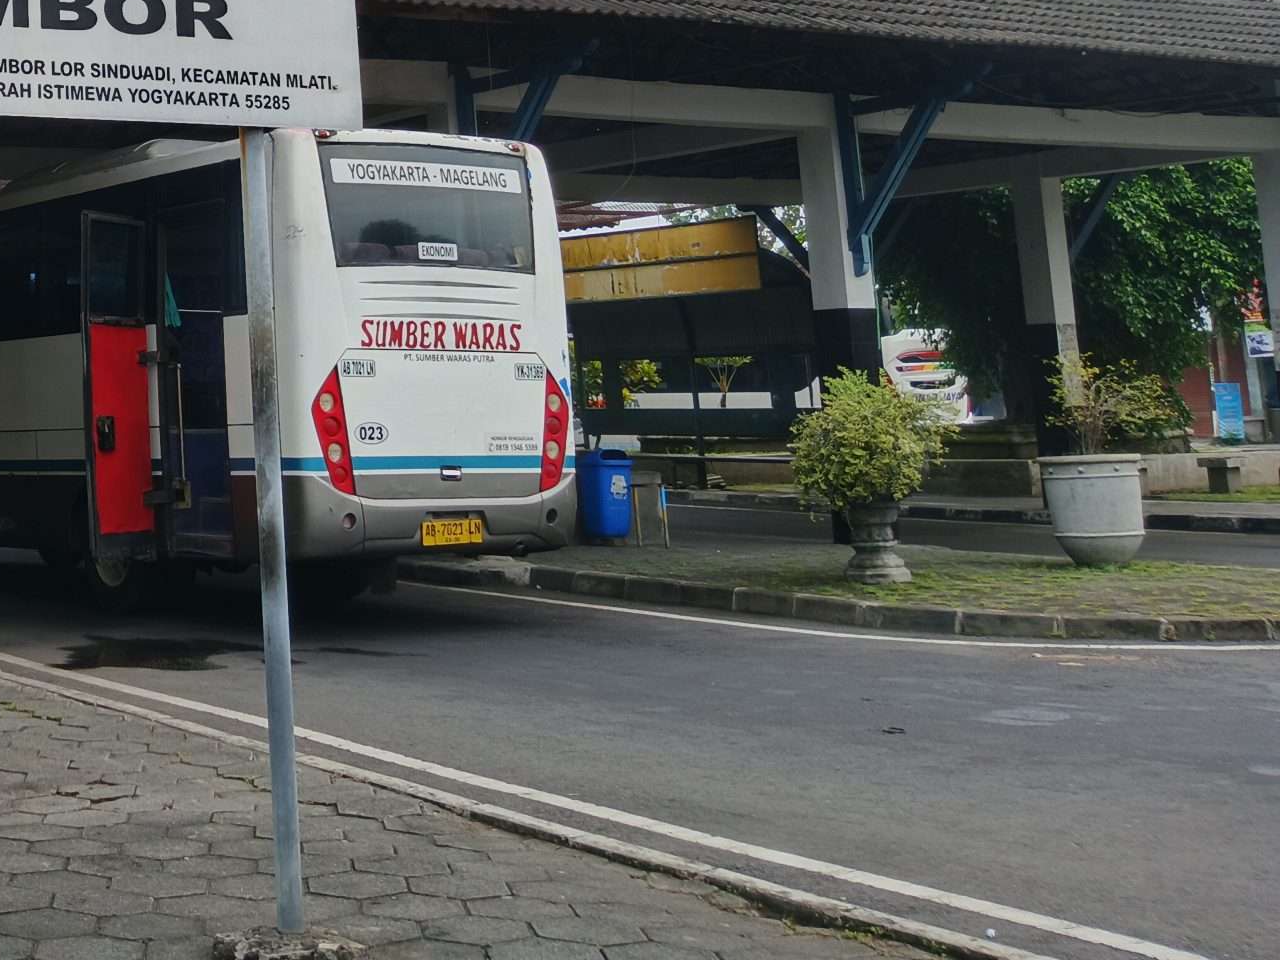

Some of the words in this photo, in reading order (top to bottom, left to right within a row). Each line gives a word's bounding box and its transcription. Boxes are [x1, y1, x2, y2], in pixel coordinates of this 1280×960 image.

[51, 60, 86, 78] LOR
[90, 62, 176, 84] SINDUADI,
[181, 67, 281, 88] KECAMATAN
[37, 83, 123, 103] ISTIMEWA
[127, 87, 241, 108] YOGYAKARTA
[245, 94, 290, 111] 55285
[347, 163, 431, 183] YOGYAKARTA
[439, 168, 508, 189] MAGELANG
[421, 245, 455, 258] EKONOMI
[360, 319, 447, 349] SUMBER
[452, 322, 522, 351] WARAS
[404, 353, 414, 362] PT.
[416, 354, 445, 362] SUMBER
[447, 354, 472, 363] WARAS
[473, 355, 495, 363] PUTRA
[343, 360, 351, 375] AB
[366, 360, 374, 375] LN
[359, 426, 384, 441] 023
[425, 523, 437, 538] AB
[468, 520, 481, 535] LN
